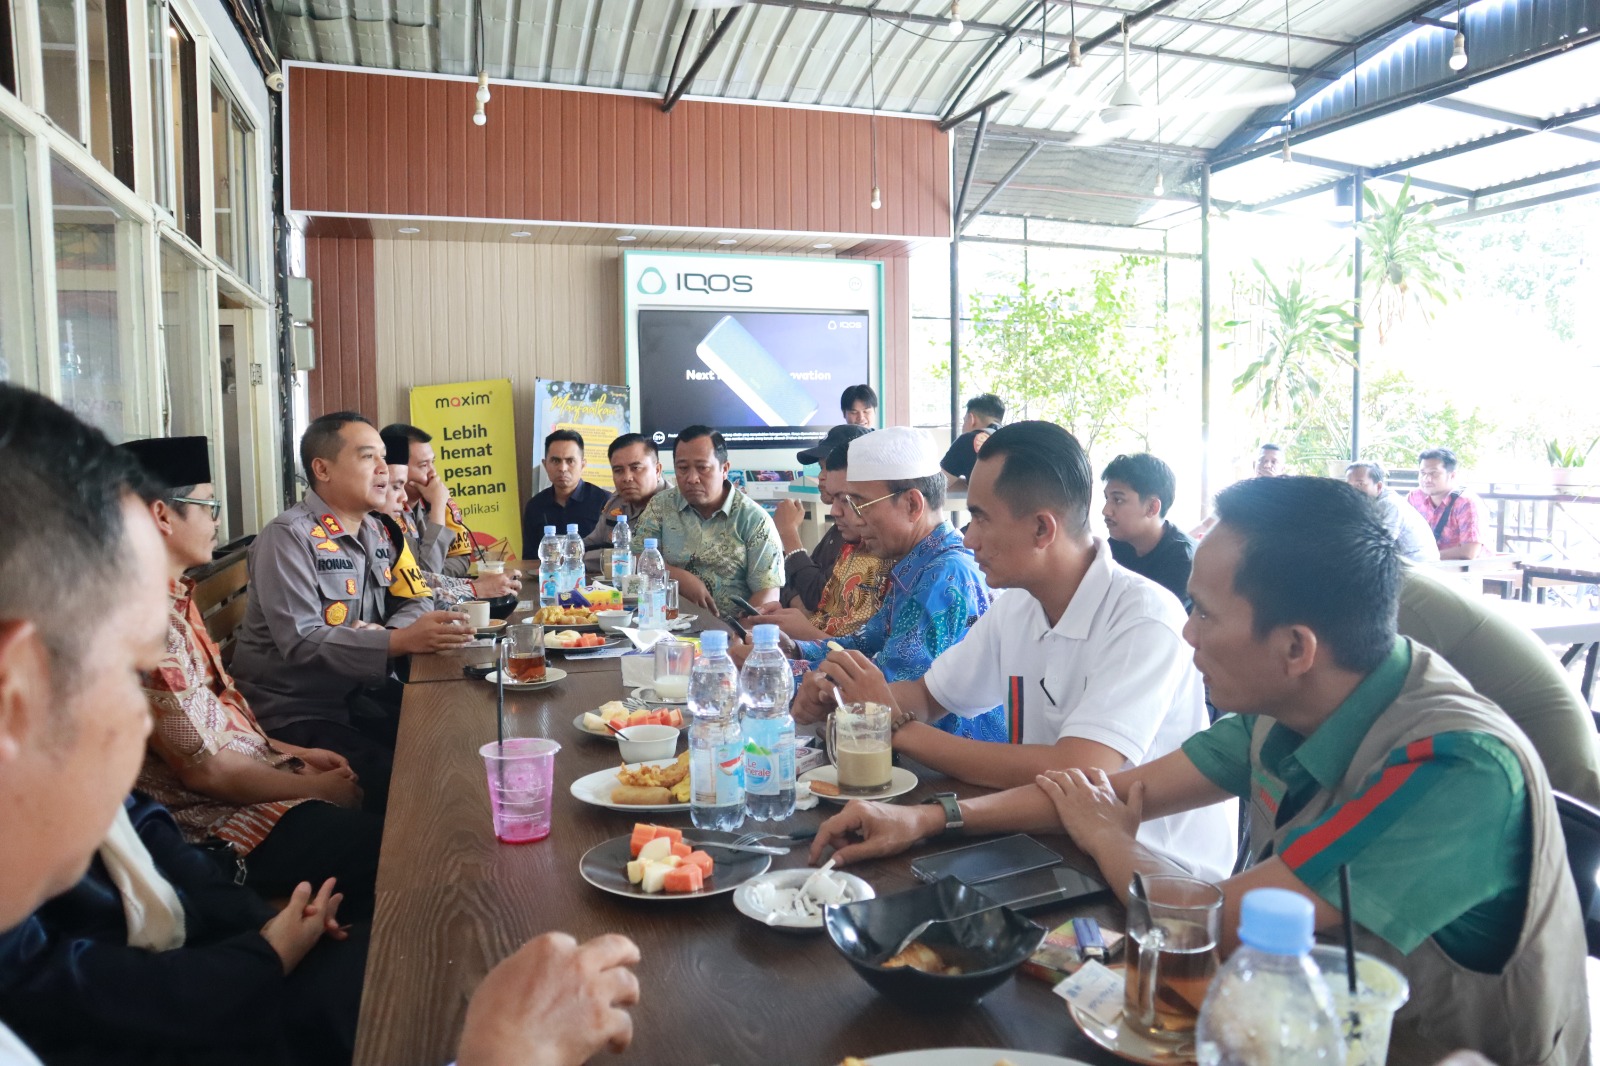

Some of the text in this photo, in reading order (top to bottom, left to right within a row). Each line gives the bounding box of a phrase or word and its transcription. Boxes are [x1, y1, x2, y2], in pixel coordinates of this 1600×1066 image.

[676, 272, 753, 294] IQOS
[839, 321, 862, 329] IQOS
[686, 370, 715, 380] Next
[435, 391, 490, 409] maxim
[550, 393, 617, 422] Manfaatkan
[443, 424, 487, 441] Lebih
[440, 443, 492, 460] hemat
[444, 464, 492, 482] pesan
[448, 482, 506, 497] akanan
[744, 766, 771, 777] nerale
